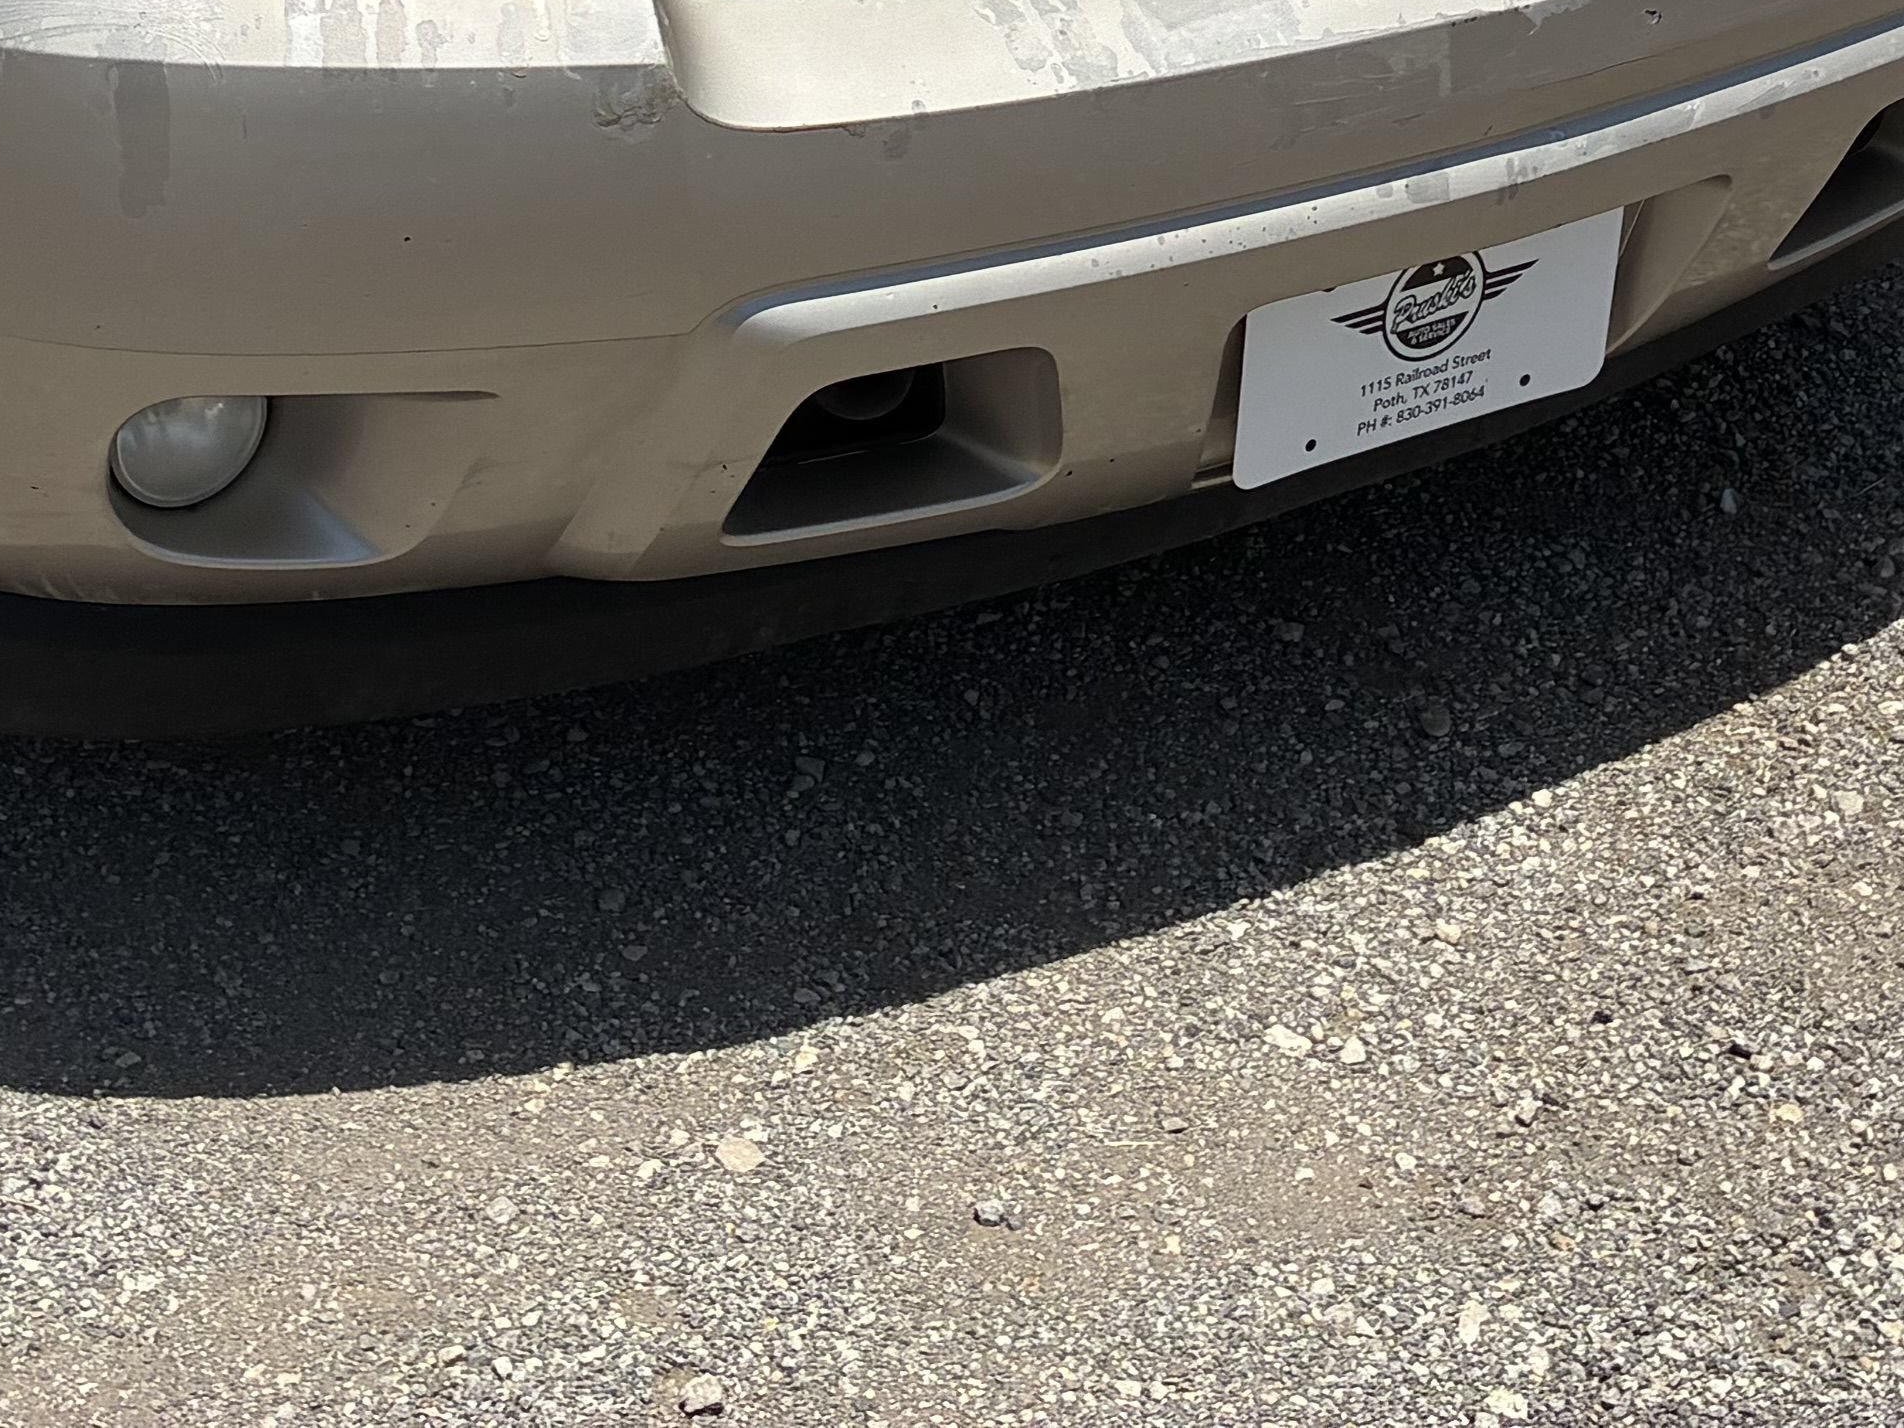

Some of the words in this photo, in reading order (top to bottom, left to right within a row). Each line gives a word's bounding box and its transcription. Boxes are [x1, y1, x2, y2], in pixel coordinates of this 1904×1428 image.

[1390, 267, 1477, 335] Pruski's
[1361, 376, 1392, 397] 1115
[1396, 358, 1450, 387] Railroad
[1451, 348, 1492, 370] Street
[1412, 382, 1430, 400] TX
[1433, 370, 1474, 394] 78147
[1357, 418, 1377, 436] PH
[1396, 385, 1485, 424] 830-391-8064
